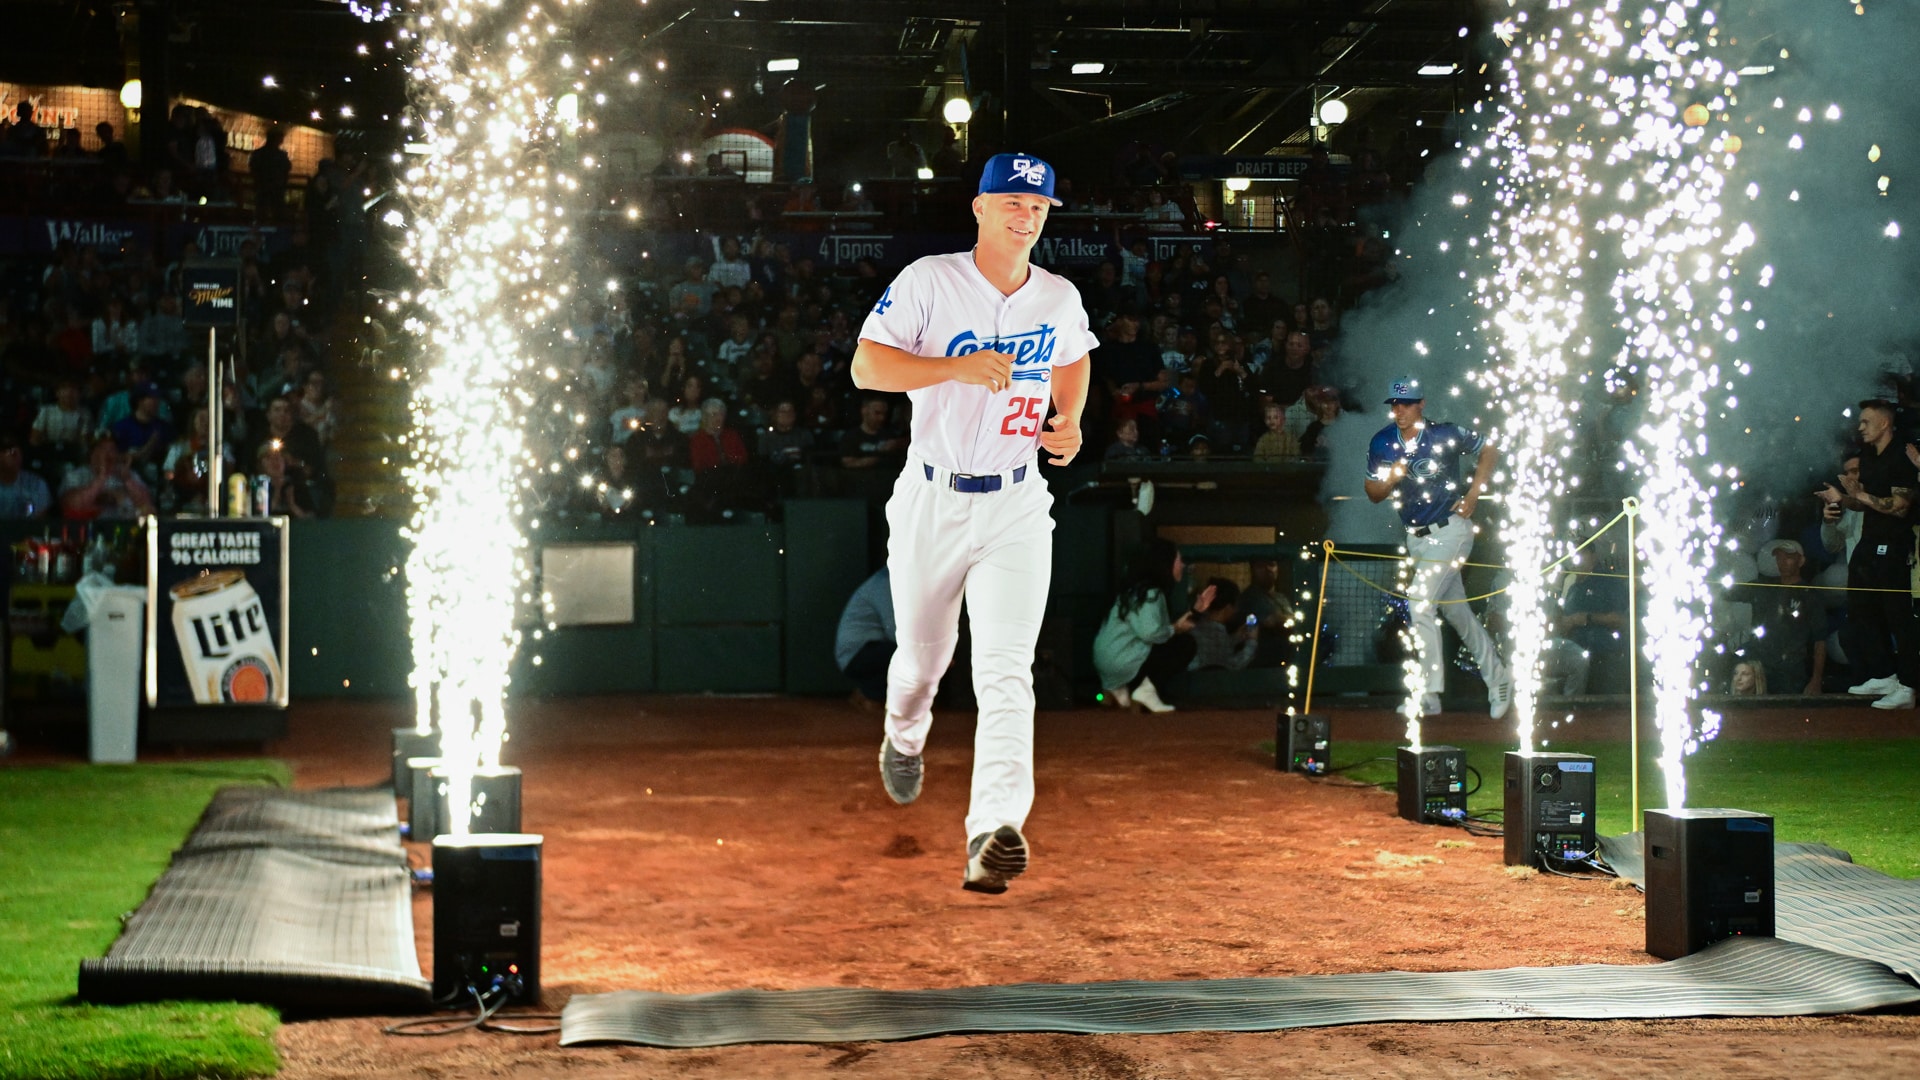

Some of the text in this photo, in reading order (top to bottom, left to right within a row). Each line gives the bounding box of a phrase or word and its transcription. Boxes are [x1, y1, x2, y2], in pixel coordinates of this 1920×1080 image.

[1235, 162, 1274, 175] DRAFT
[1033, 237, 1108, 264] Walker
[212, 298, 233, 308] TIME
[1000, 397, 1043, 437] 25
[171, 532, 260, 548] GREAT TASTE
[171, 550, 260, 565] 96 CALORIES
[191, 603, 263, 658] Lite
